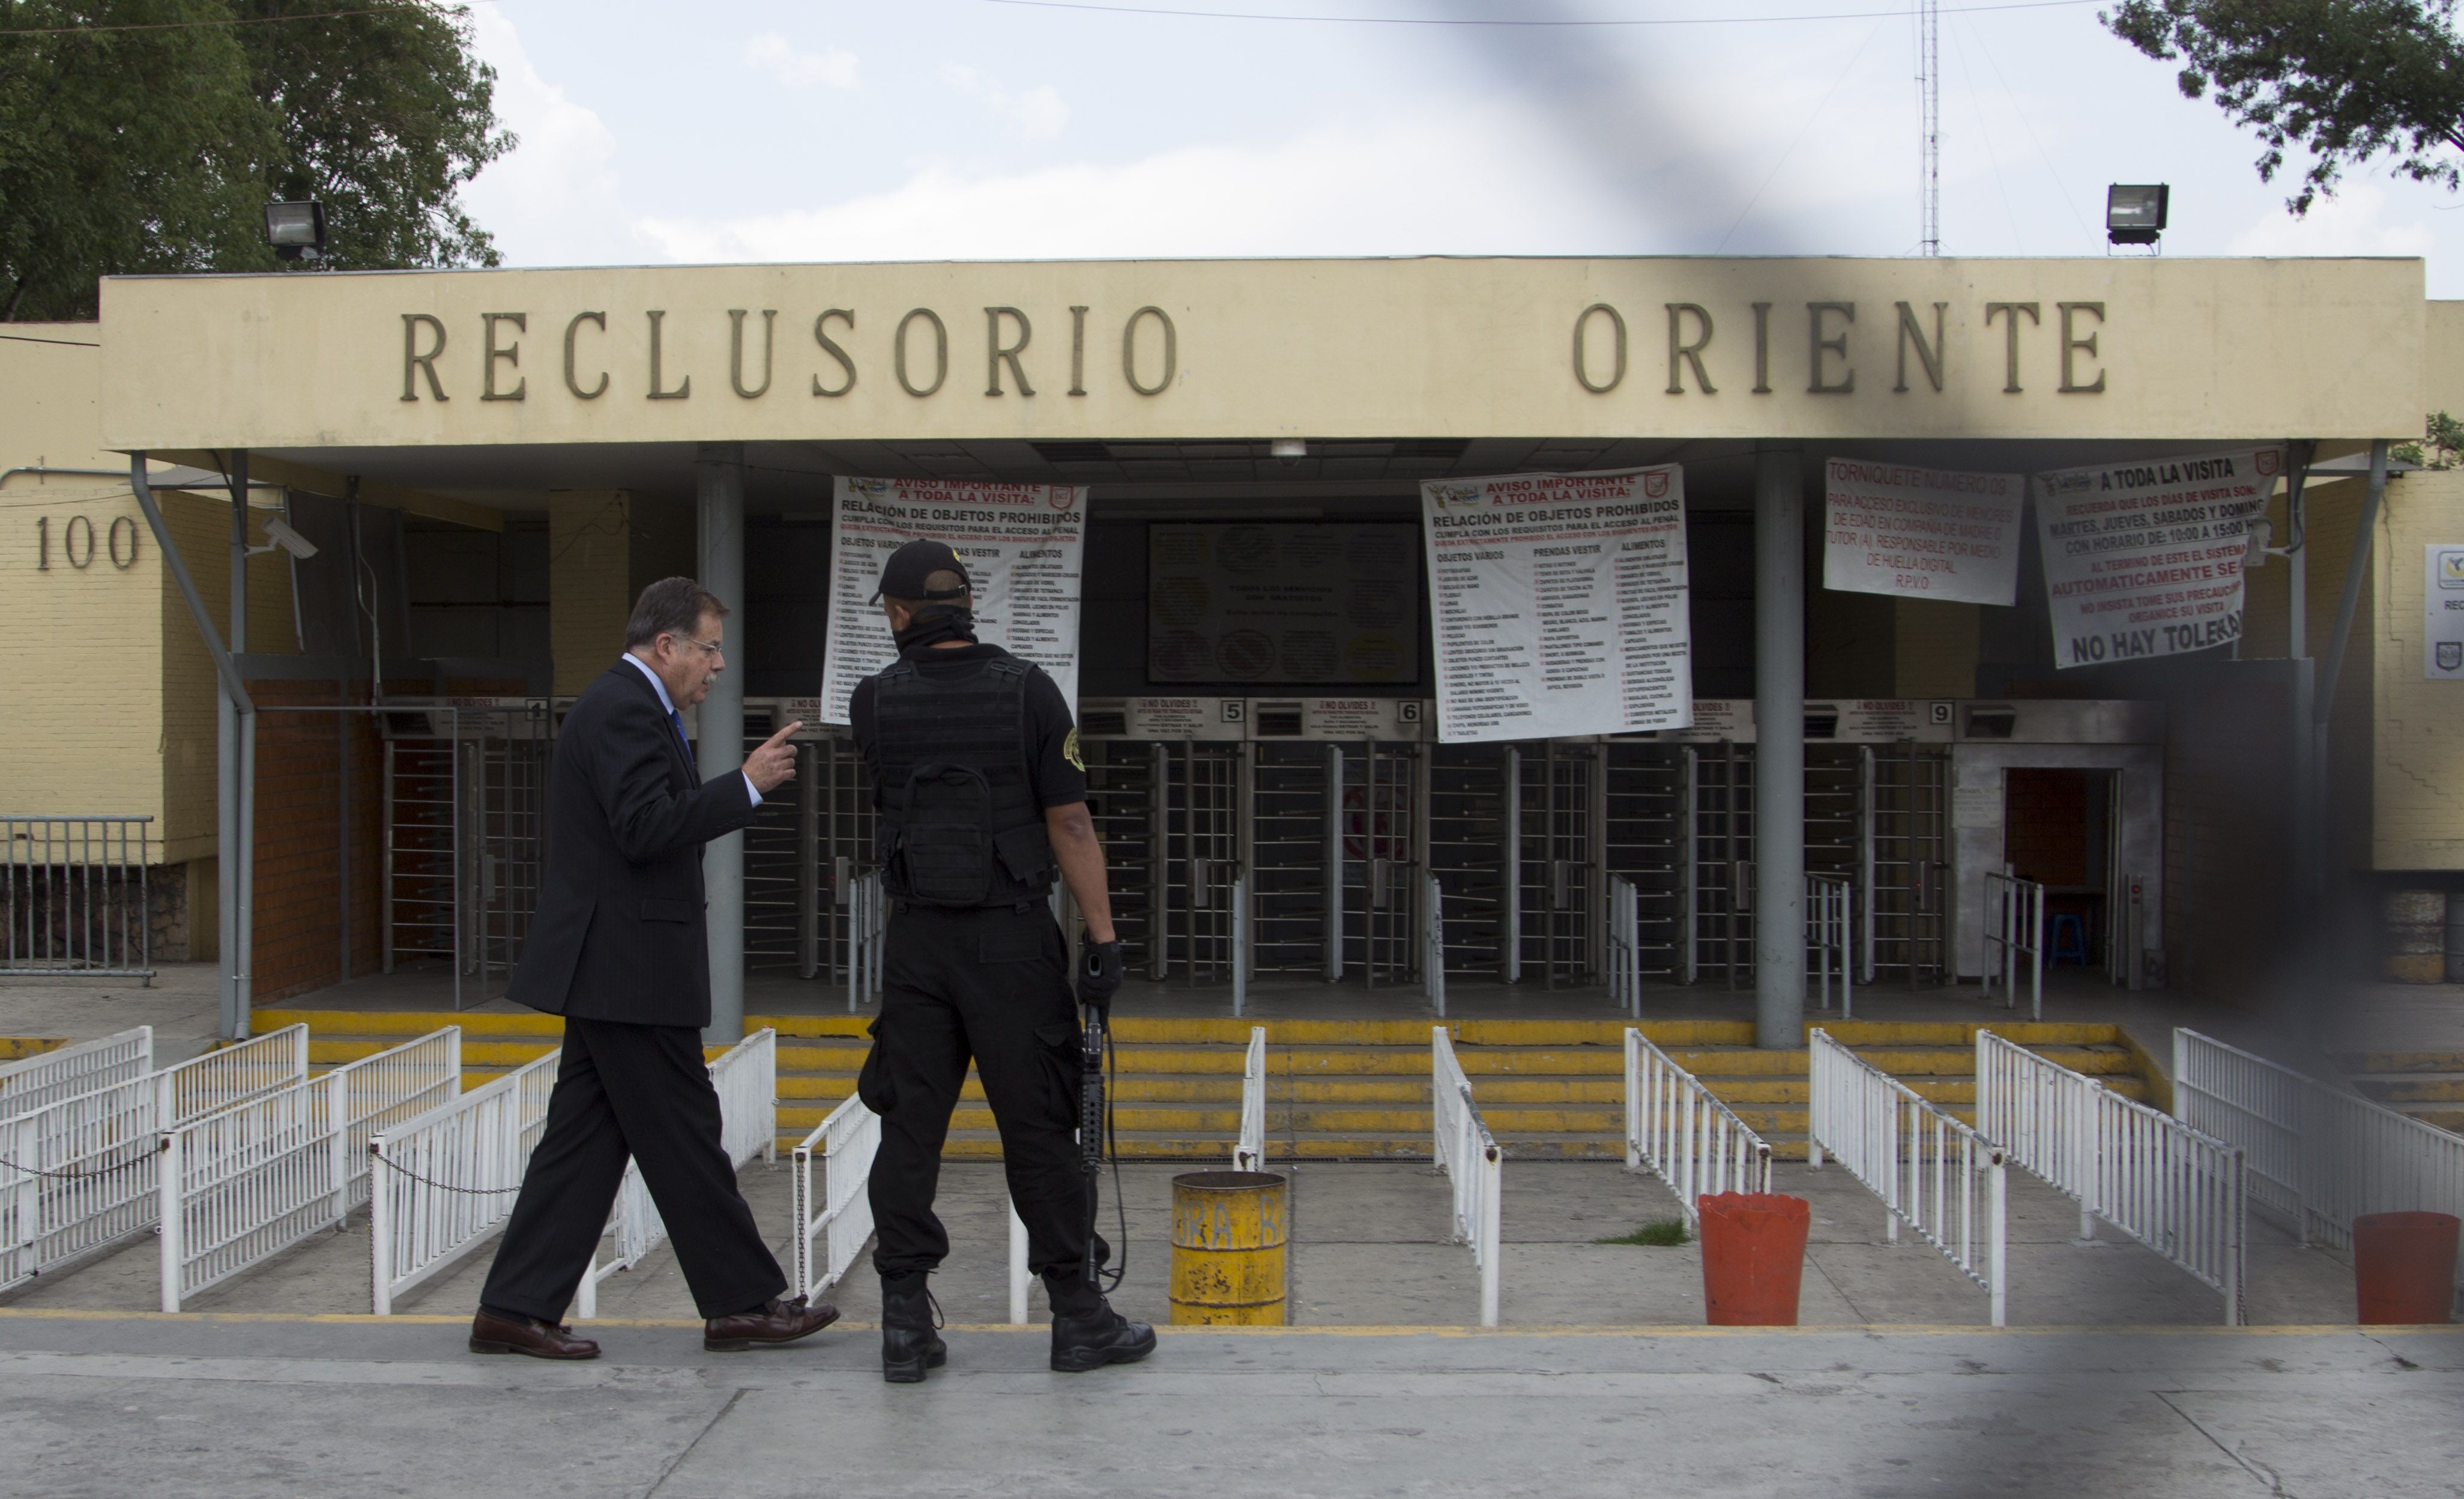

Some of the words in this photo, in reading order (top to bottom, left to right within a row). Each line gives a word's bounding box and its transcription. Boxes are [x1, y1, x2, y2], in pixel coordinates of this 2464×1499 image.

[400, 307, 1178, 401] RECLUSORIO
[1573, 301, 2106, 395] ORIENTE
[894, 479, 938, 488] AVISO
[944, 479, 1042, 492] IMPORTANTE
[1486, 481, 1532, 494] AVISO
[1536, 475, 1636, 490] IMPORTANTE
[1829, 461, 1921, 488] TORNIQUETE
[2101, 471, 2112, 491] A
[2115, 467, 2157, 489] TODA
[2159, 464, 2181, 484] LA
[2183, 458, 2235, 481] VISITA
[899, 490, 908, 499] A
[914, 490, 953, 501] TODA
[958, 492, 977, 502] LA
[982, 492, 1035, 504] VISITA:
[1493, 494, 1503, 504] A
[1508, 491, 1548, 503] TODA
[1553, 489, 1572, 501] LA
[1576, 487, 1631, 499] VISITA:
[1828, 492, 1853, 507] PARA
[1855, 495, 1894, 512] ACCESO
[1895, 499, 1950, 516] EXCLUSIVO
[1951, 504, 1965, 519] DE
[2119, 498, 2139, 510] QUE
[2142, 495, 2160, 508] LOS
[2186, 491, 2199, 503] DE
[2200, 488, 2232, 501] VISITA
[841, 515, 875, 524] CUMPLA
[896, 521, 913, 530] LOS
[916, 522, 966, 532] REQUISITOS
[842, 500, 906, 518] RELACIÓN
[911, 508, 928, 519] DE
[932, 509, 995, 522] OBJETOS
[999, 512, 1081, 524] PROHIBIDOS
[1433, 511, 1502, 527] RELACIÓN
[1506, 512, 1524, 523] DE
[1529, 507, 1593, 522] OBJETOS
[1596, 499, 1680, 518] PROHIBIDOS
[2208, 506, 2217, 518] Y
[1435, 528, 1470, 539] CUMPLA
[1472, 528, 1491, 536] CON
[1493, 527, 1509, 535] LOS
[1511, 524, 1563, 534] REQUISITOS
[1604, 519, 1638, 528] ACCESO
[1652, 514, 1680, 523] PENAL
[1834, 512, 1847, 526] DE
[1850, 513, 1876, 528] EDAD
[1877, 516, 1892, 530] EN
[1943, 522, 1957, 536] DE
[1960, 524, 1993, 540] MADRE
[2066, 540, 2090, 554] CON
[2093, 533, 2145, 551] HORARIO
[2148, 530, 2166, 544] DE:
[2169, 527, 2199, 542] 10:00
[2202, 525, 2211, 539] A
[2213, 521, 2244, 537] 15:00
[37, 515, 138, 569] 100
[841, 537, 875, 547] OBJETOS
[972, 548, 1000, 558] VESTIR
[1019, 550, 1063, 559] ALIMENTOS
[1437, 552, 1473, 562] OBJETOS
[1475, 550, 1505, 561] VARIOS
[1533, 547, 1571, 557] PRENDAS
[1572, 544, 1602, 555] VESTIR
[1622, 539, 1665, 551] ALIMENTOS
[1826, 530, 1857, 546] TUTOR
[1876, 534, 1945, 554] RESPONSABLE
[1948, 542, 1969, 557] POR
[1970, 544, 2002, 560] MEDIO
[1867, 553, 1882, 567] DE
[1883, 555, 1919, 571] HUELLA
[2091, 562, 2103, 573] AL
[2151, 554, 2164, 566] DE
[2166, 551, 2190, 565] ESTE
[2191, 550, 2205, 562] EL
[2052, 565, 2214, 596] AUTOMATICAMENTE
[2217, 562, 2238, 577] SE
[2165, 592, 2185, 604] SUS
[2180, 605, 2194, 617] SU
[2072, 635, 2106, 663] NO
[2111, 628, 2156, 658] HAY
[1227, 704, 1240, 719] 5
[1404, 704, 1417, 720] 6
[1935, 706, 1948, 721] 9
